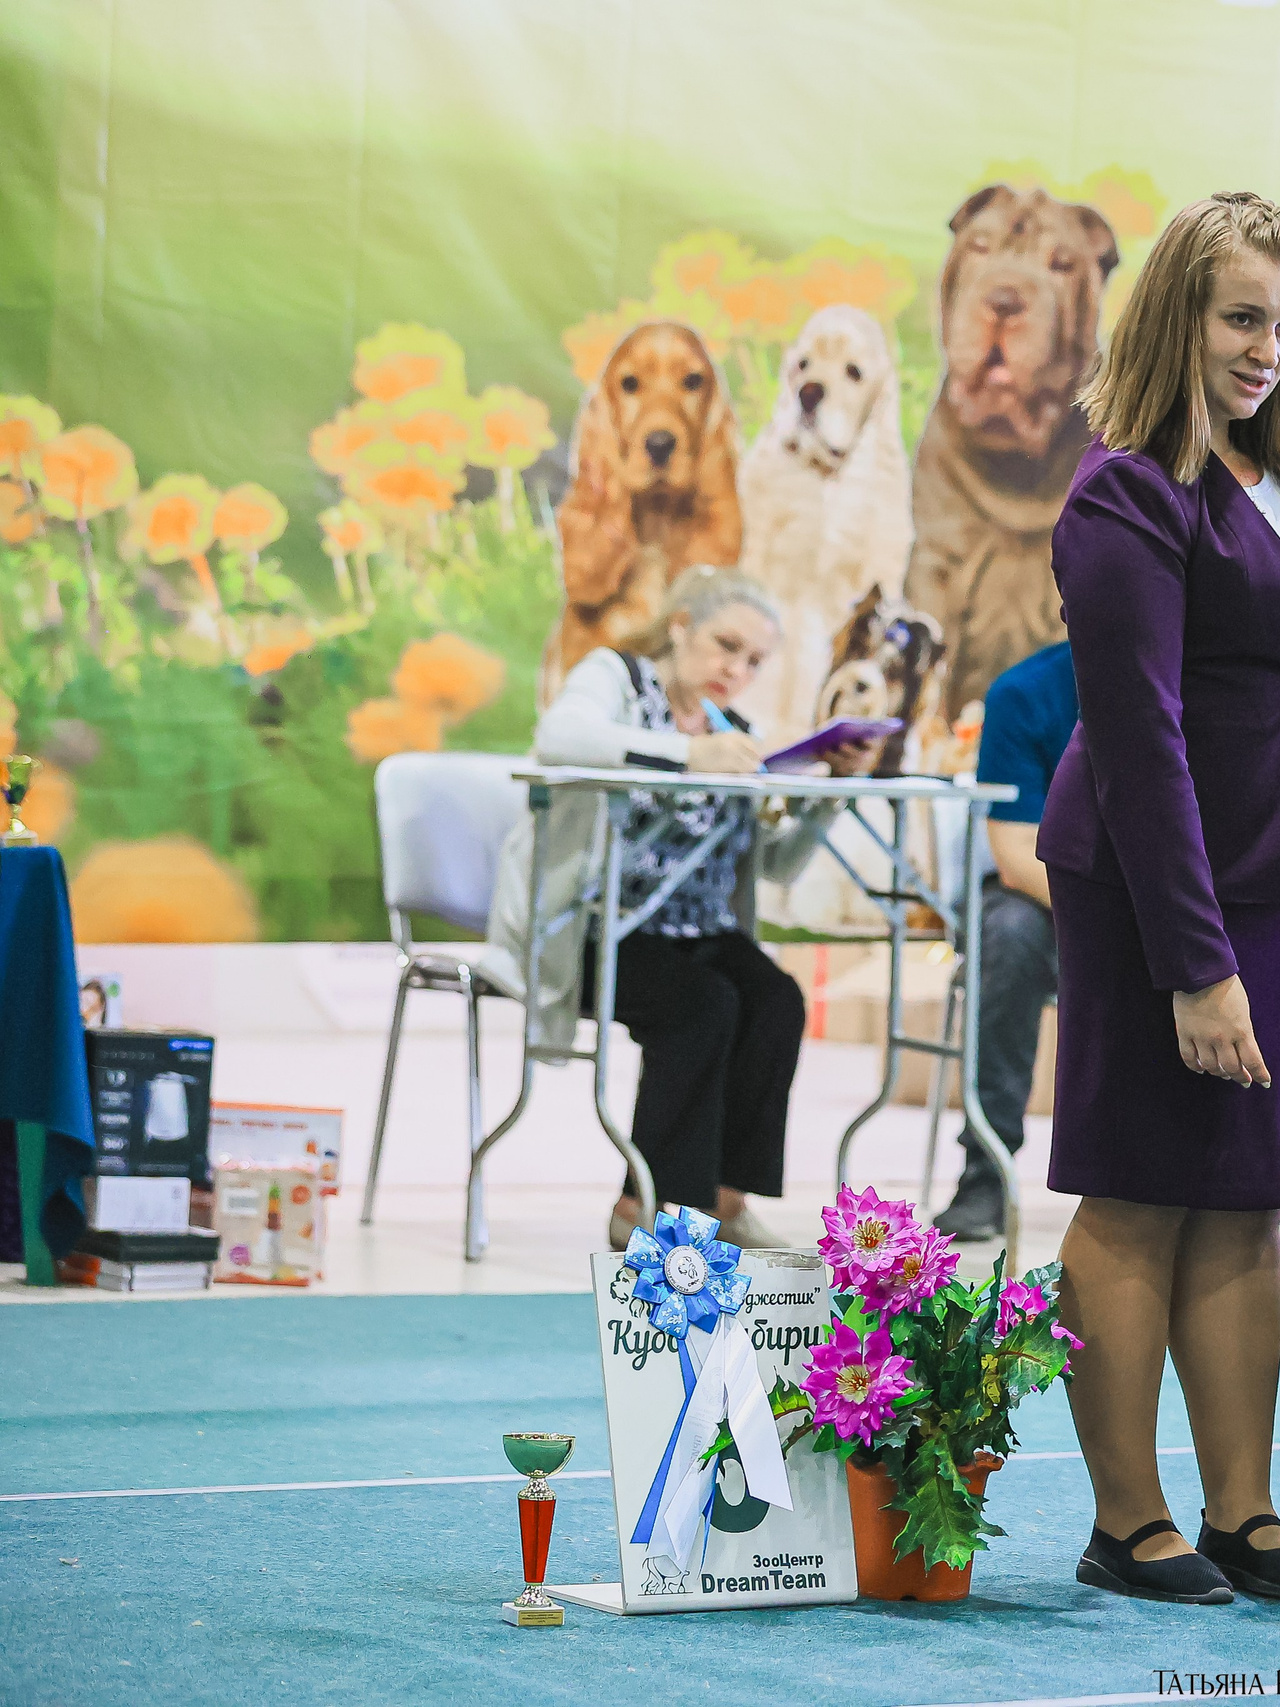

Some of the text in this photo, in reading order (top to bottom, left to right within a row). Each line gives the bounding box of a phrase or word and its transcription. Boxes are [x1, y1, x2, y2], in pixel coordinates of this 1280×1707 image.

[744, 1318, 823, 1366] бири
[752, 1553, 824, 1569] ЗооЦентр
[700, 1569, 826, 1594] DreamTeam
